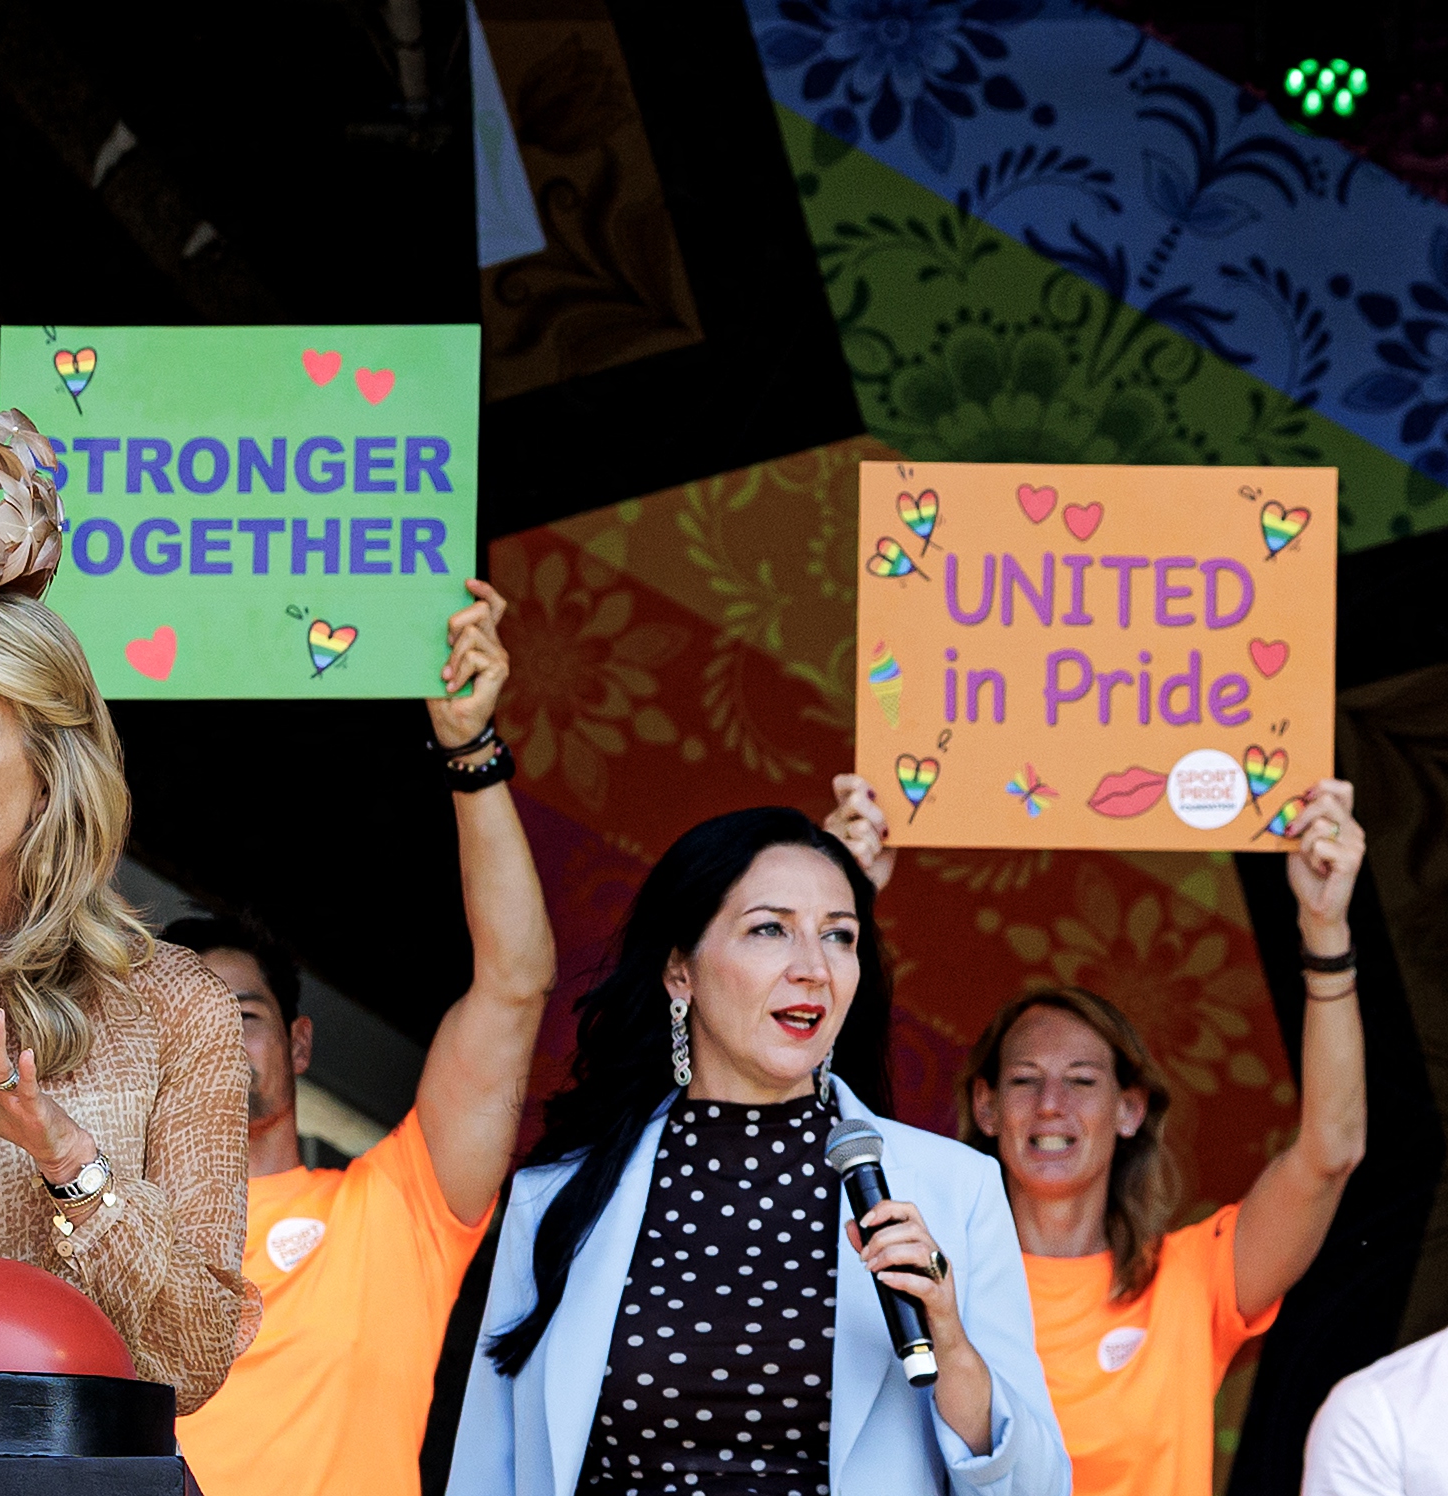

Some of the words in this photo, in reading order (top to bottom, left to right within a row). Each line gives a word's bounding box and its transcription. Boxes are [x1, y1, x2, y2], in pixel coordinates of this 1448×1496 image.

[60, 517, 450, 576] OGETHER
[945, 552, 1254, 630] UNITED
[945, 648, 1006, 723] in
[1043, 649, 1251, 727] Pride
